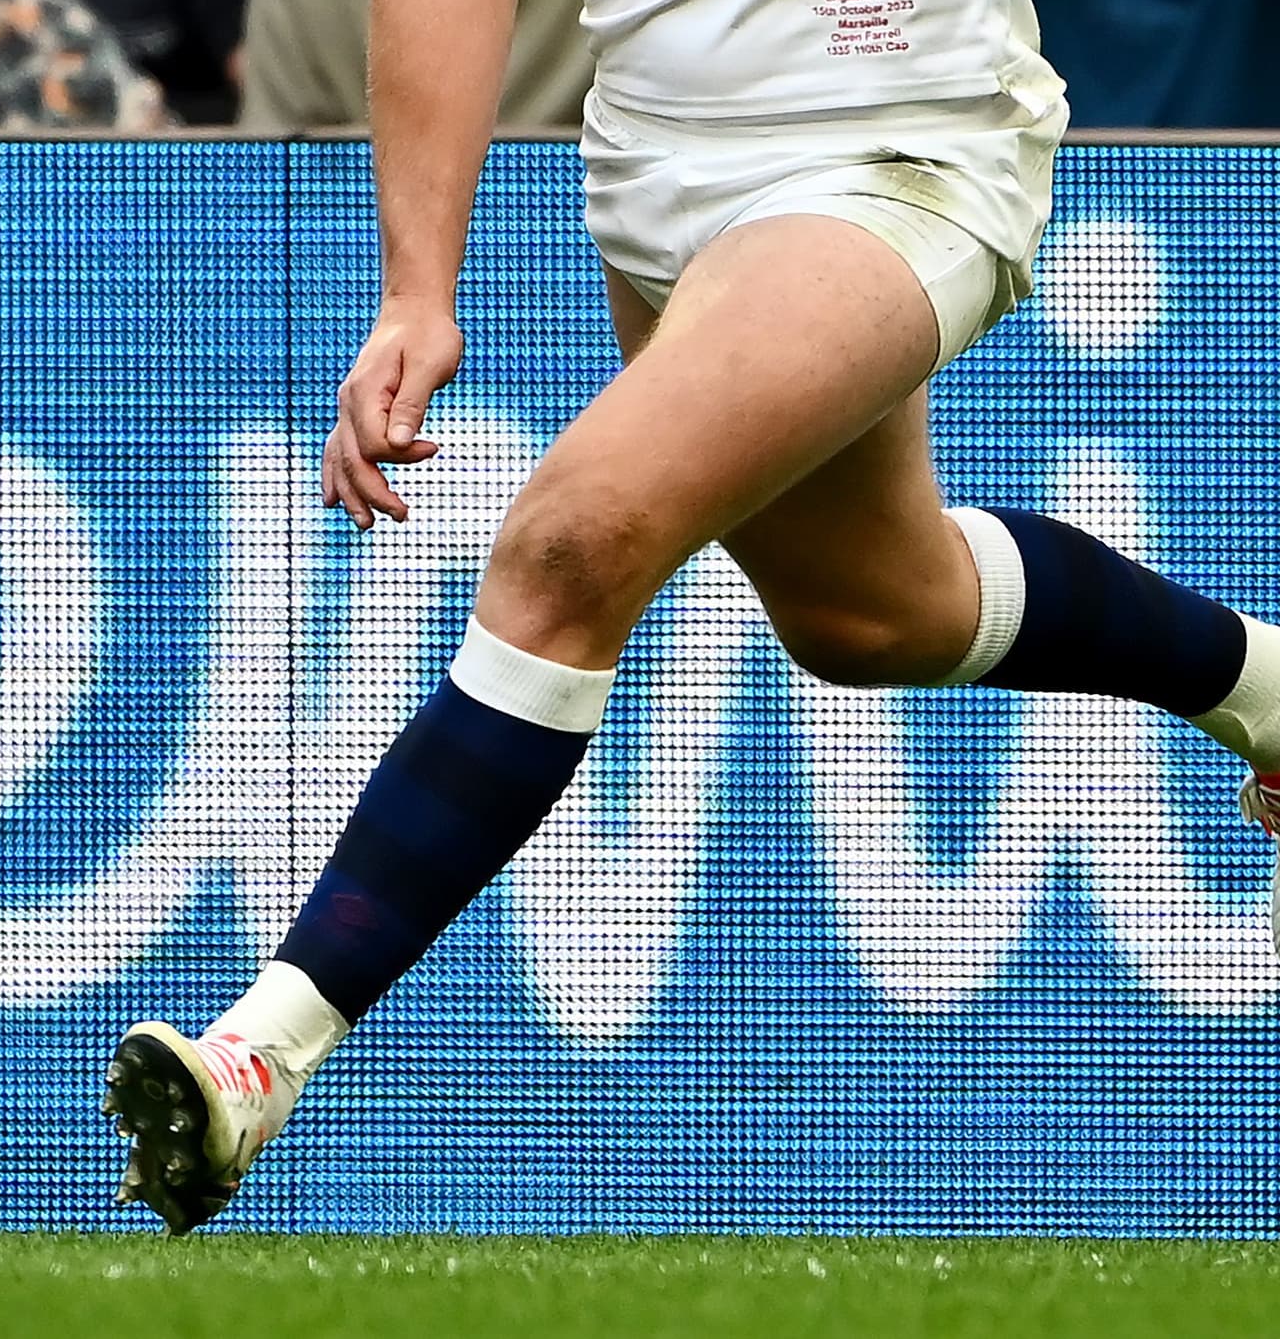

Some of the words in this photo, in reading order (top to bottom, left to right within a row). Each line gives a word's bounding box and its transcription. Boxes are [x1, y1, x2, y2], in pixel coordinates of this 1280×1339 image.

[812, 6, 837, 16] 15th
[839, 5, 883, 15] October
[887, 0, 914, 11] 2023
[838, 17, 889, 28] Marseille
[831, 32, 862, 43] Owen
[865, 28, 901, 40] Farrell
[854, 45, 883, 55] 110th
[886, 41, 910, 52] Cap
